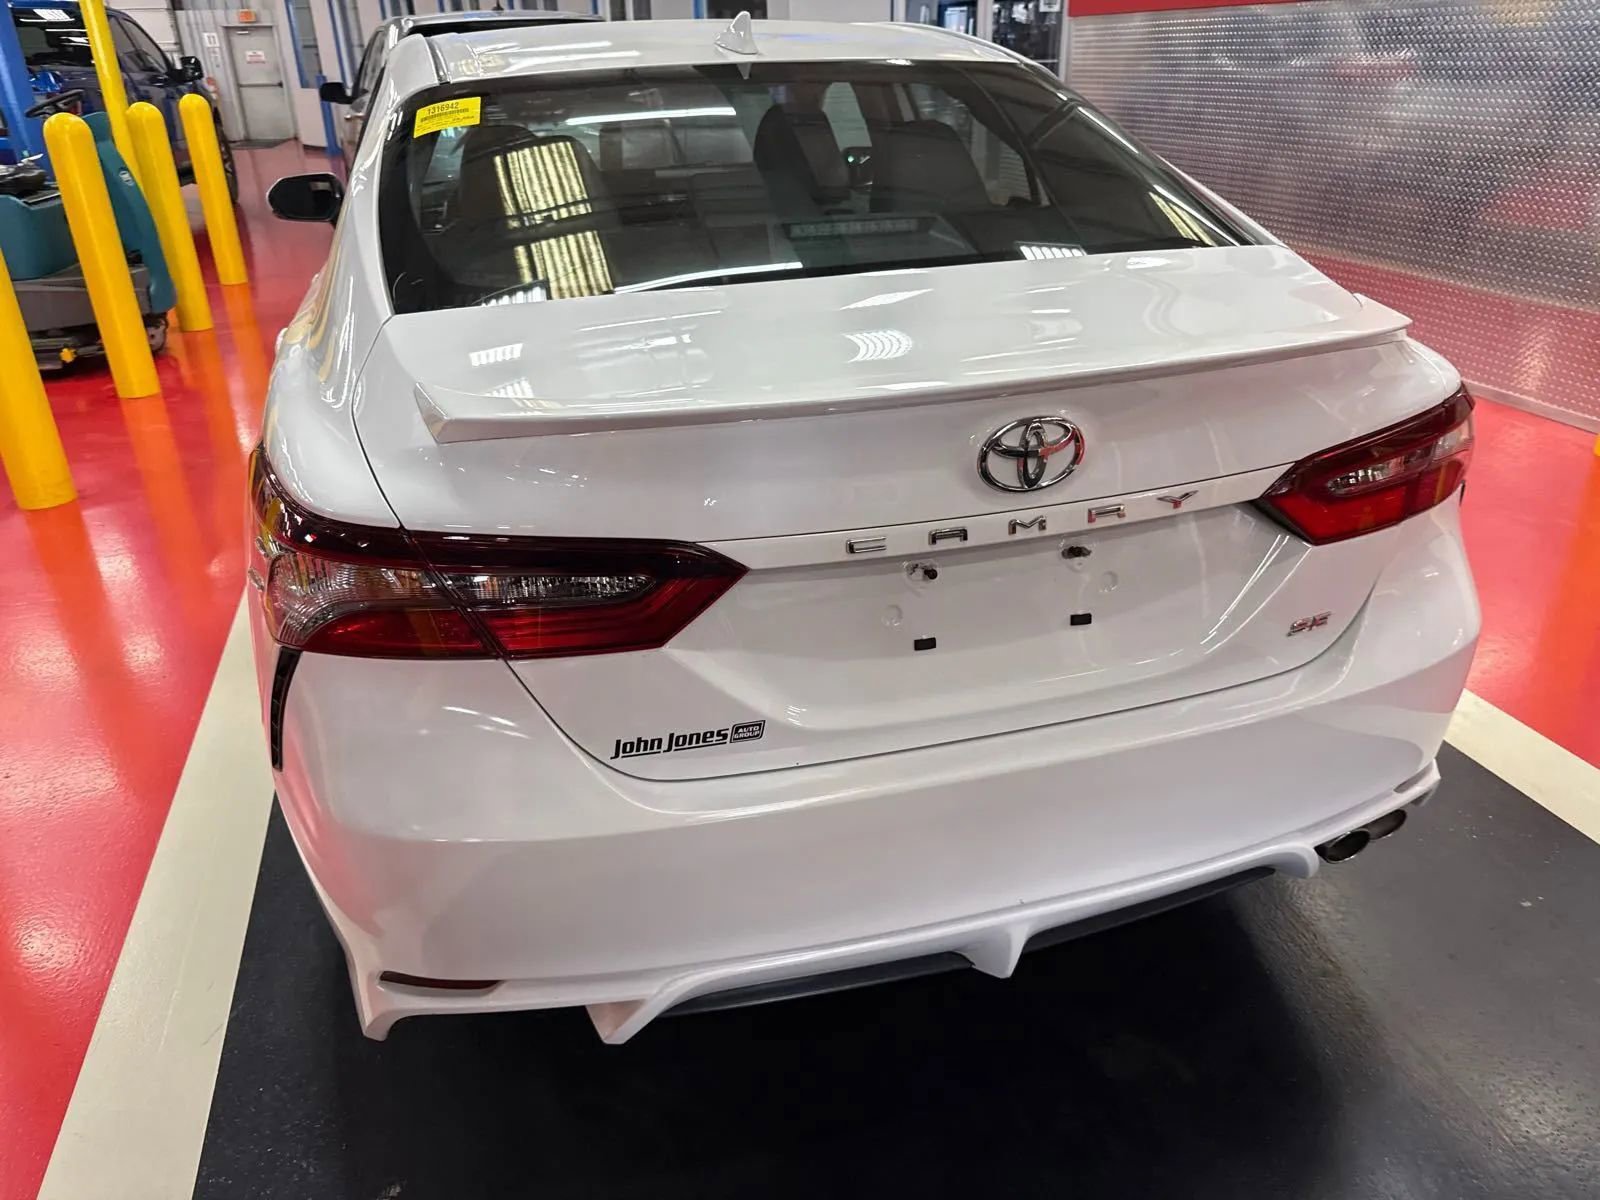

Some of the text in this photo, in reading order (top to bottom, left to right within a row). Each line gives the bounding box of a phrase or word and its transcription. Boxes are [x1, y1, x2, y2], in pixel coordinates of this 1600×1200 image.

[427, 102, 459, 115] 1316942
[846, 490, 1199, 555] CAMRY
[1287, 611, 1331, 637] SE
[734, 730, 761, 739] GROUP
[737, 725, 760, 734] AUTO
[610, 728, 730, 760] John Jones
